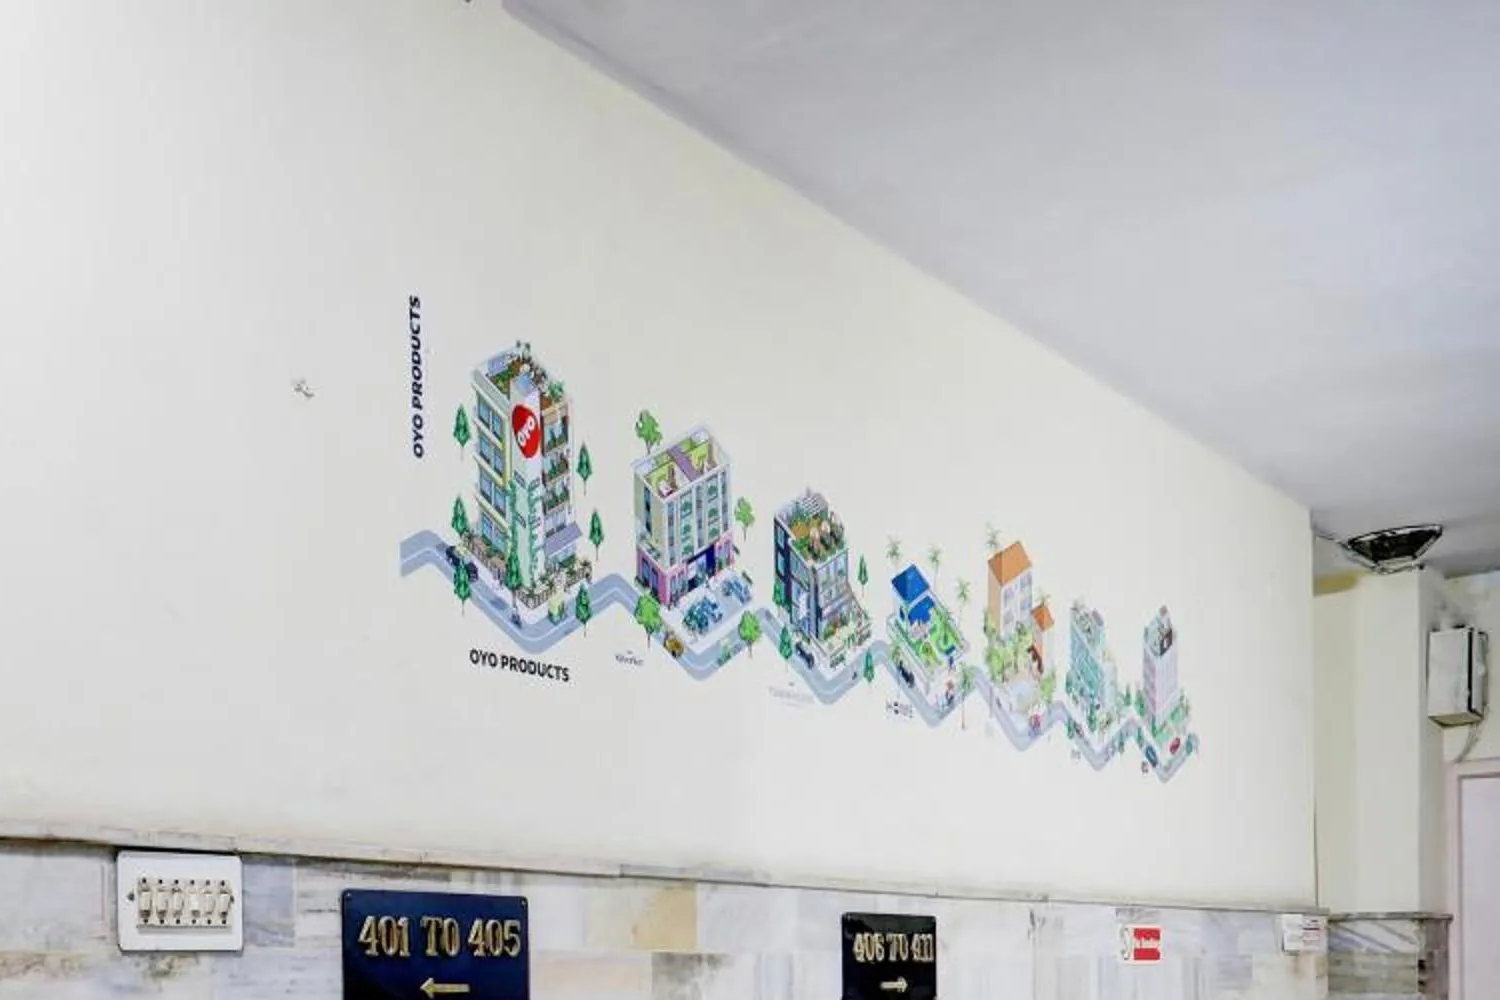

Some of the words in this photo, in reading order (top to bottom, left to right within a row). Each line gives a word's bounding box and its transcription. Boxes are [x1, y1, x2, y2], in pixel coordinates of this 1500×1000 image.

[409, 294, 423, 411] PRODUCTS
[412, 413, 425, 459] OYO
[469, 648, 498, 668] OYO
[501, 654, 570, 682] PRODUCTS
[358, 915, 411, 957] 401
[420, 916, 461, 957] TO
[468, 918, 521, 957] 405
[853, 933, 885, 962] 406
[886, 933, 909, 961] TO
